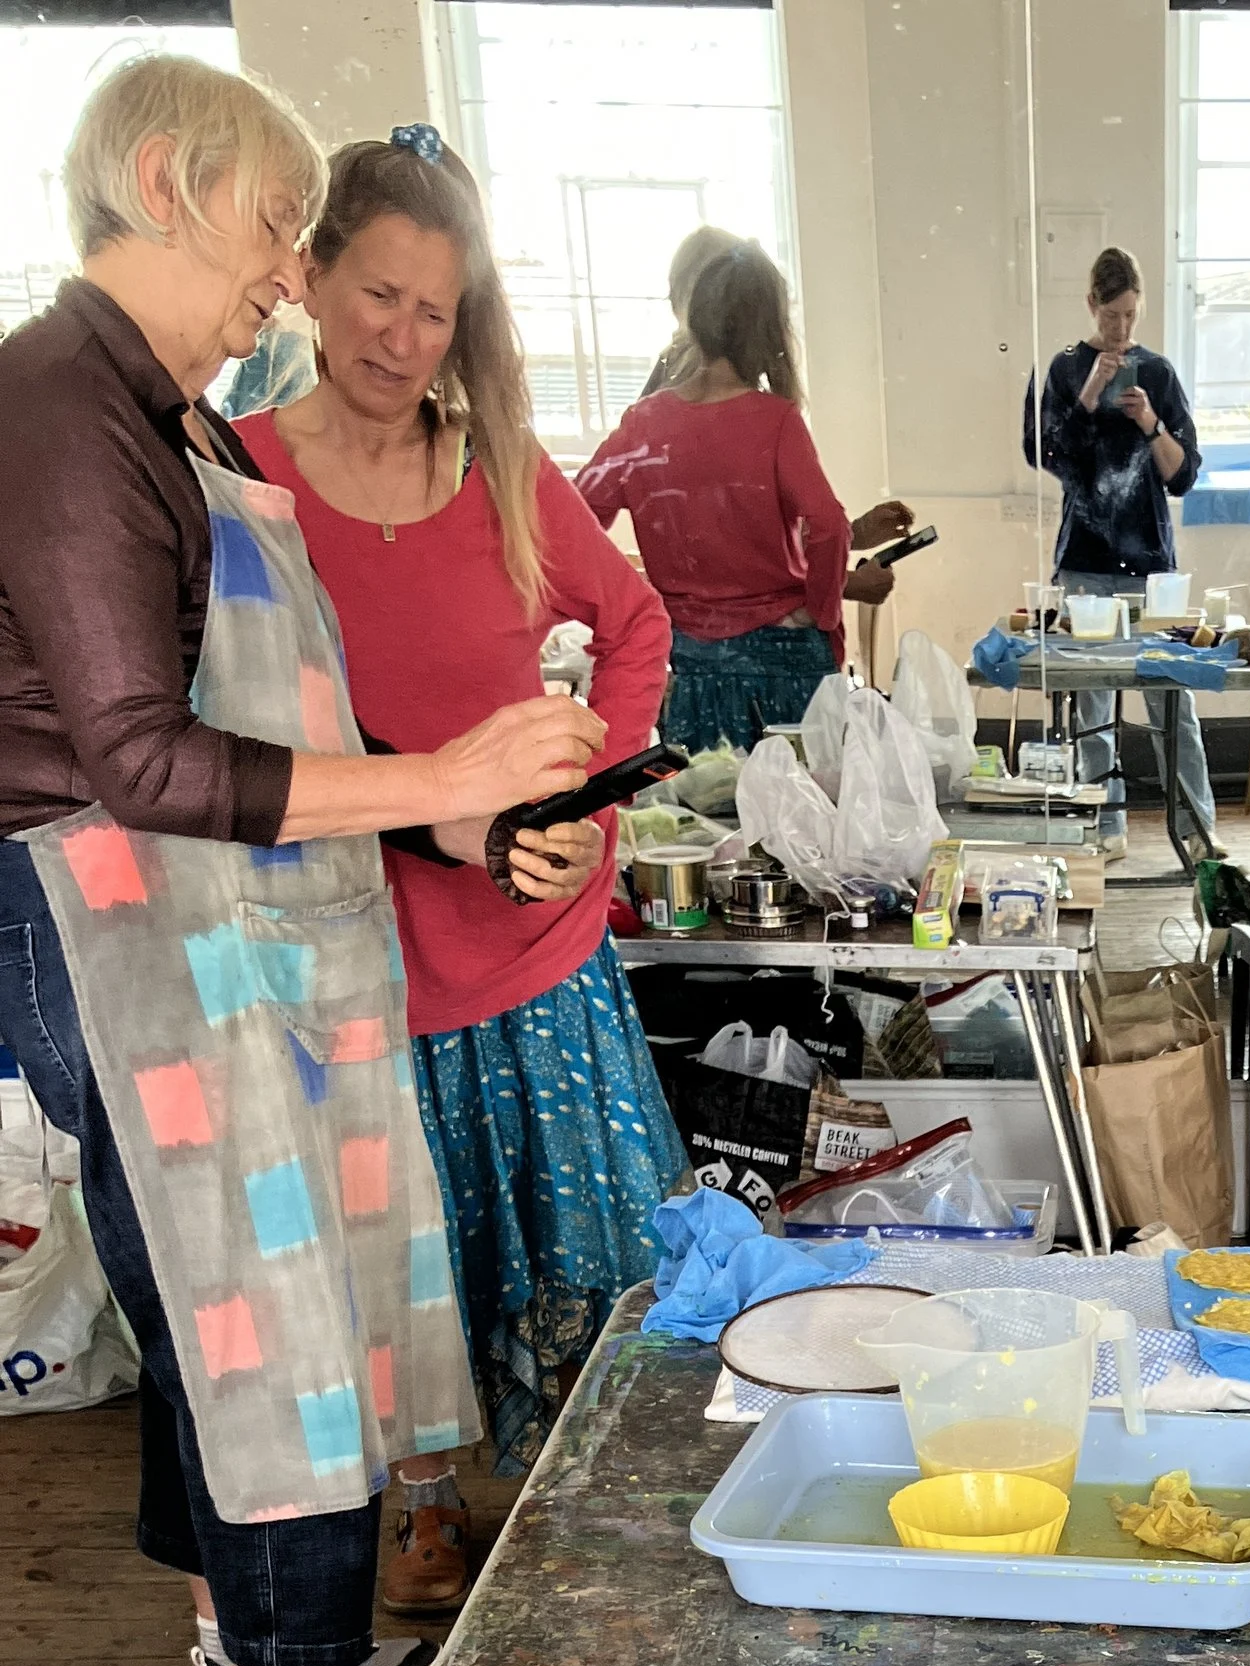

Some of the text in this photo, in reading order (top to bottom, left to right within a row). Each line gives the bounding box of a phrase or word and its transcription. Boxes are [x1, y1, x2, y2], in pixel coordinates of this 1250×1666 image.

[827, 1128, 860, 1145] BEAK
[713, 1138, 751, 1159] RECYCLED
[752, 1147, 790, 1167] CONTENT
[824, 1143, 871, 1161] STREET
